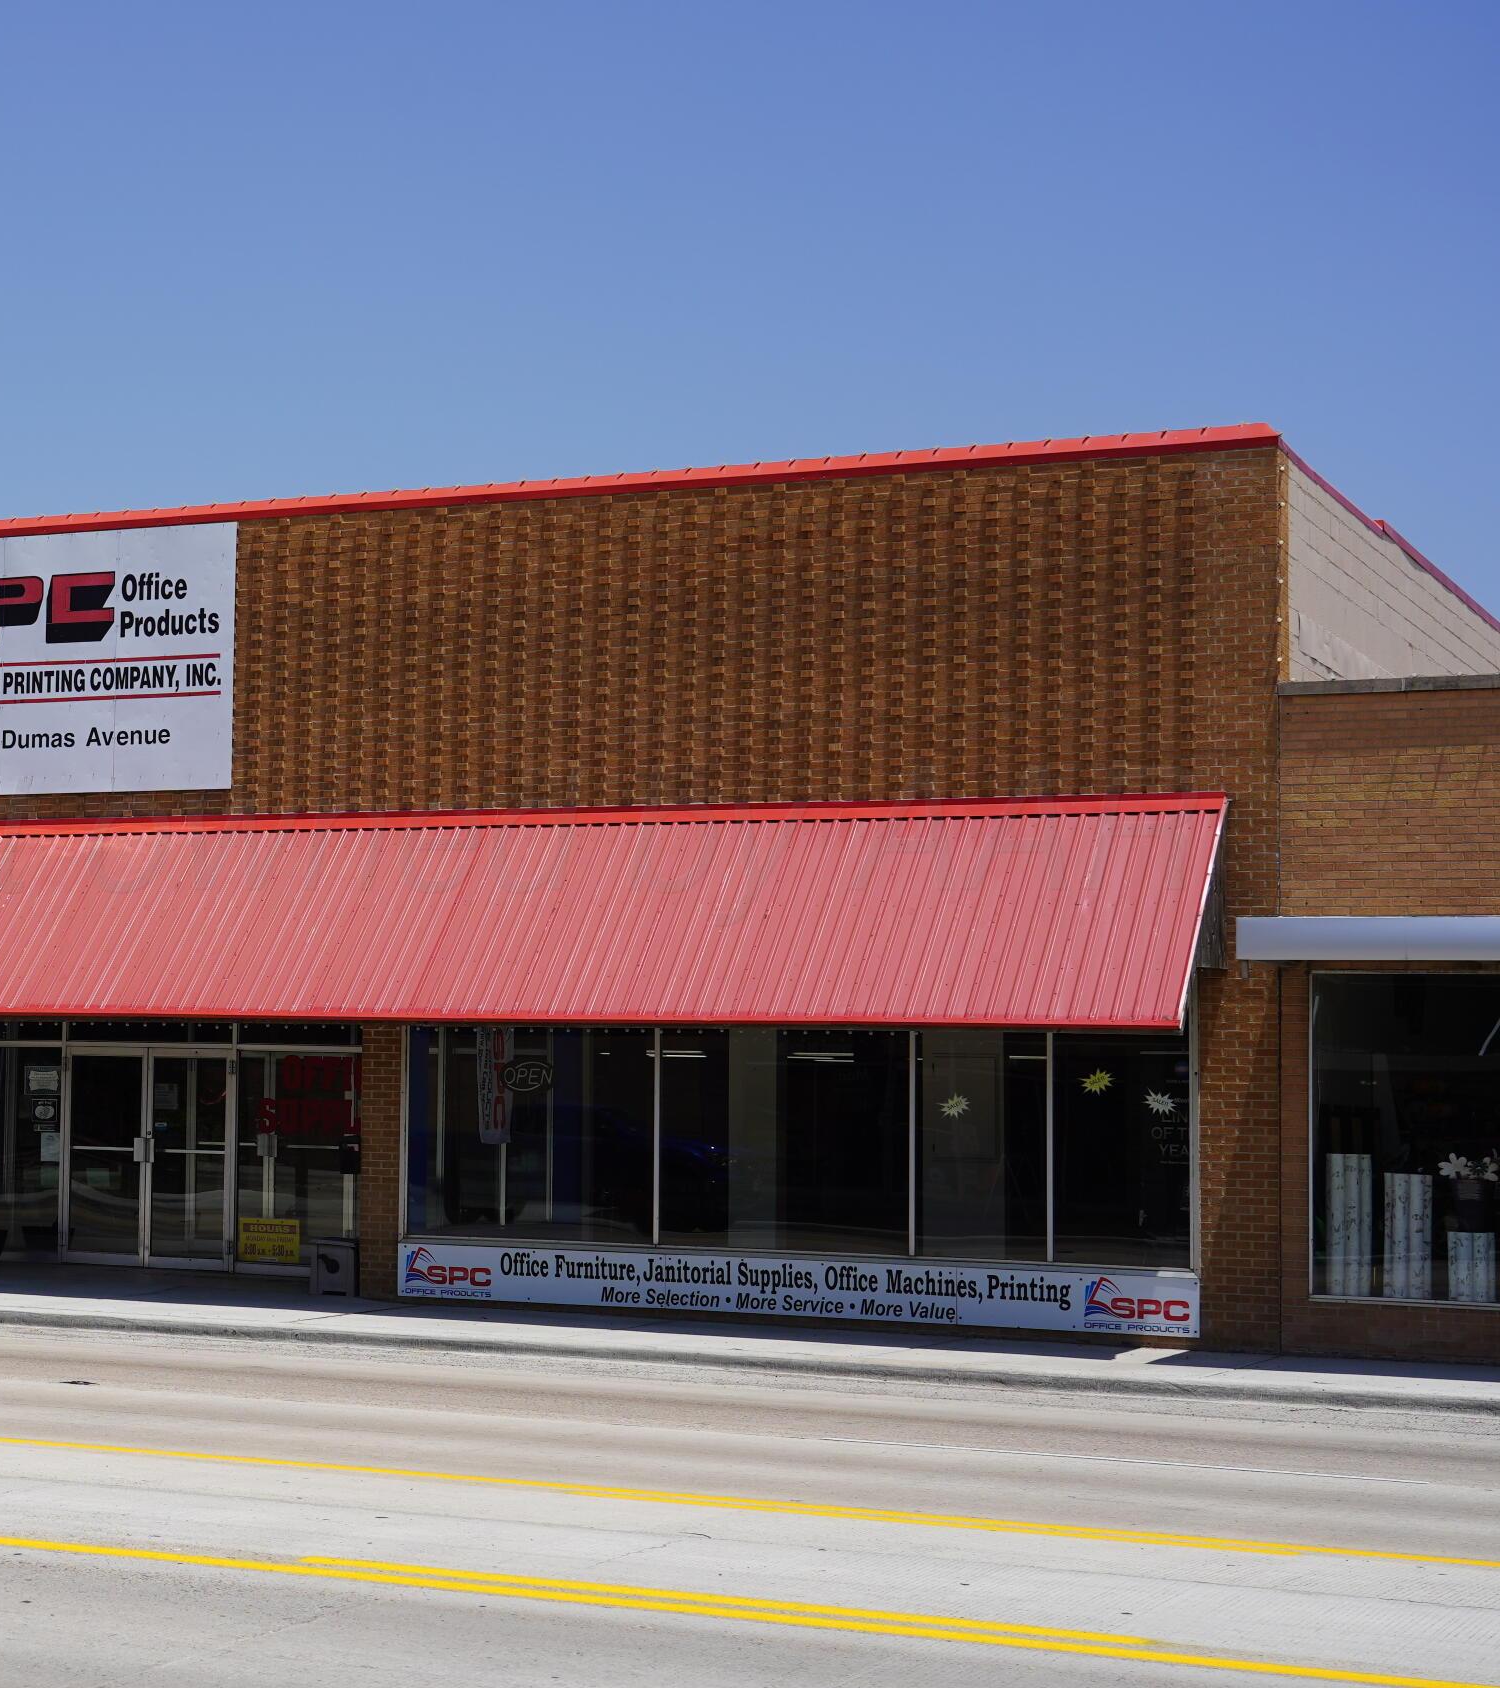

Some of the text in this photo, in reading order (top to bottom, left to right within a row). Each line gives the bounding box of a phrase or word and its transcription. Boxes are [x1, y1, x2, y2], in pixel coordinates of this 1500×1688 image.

[121, 572, 188, 602] Office
[120, 607, 220, 638] Products
[3, 668, 86, 695] PRINTING
[89, 664, 180, 692] COMPANY,
[185, 662, 222, 687] INC.
[1, 728, 76, 750] Dumas
[86, 725, 171, 747] Avenue
[504, 1066, 553, 1085] OPEN
[249, 1224, 290, 1233] HOURS
[426, 1265, 492, 1287] SPC
[500, 1253, 1071, 1311] Office Furniture, Janitorial Supplies, Office Machines, Printing
[404, 1286, 492, 1299] OFFICE PRODUCTS
[600, 1286, 643, 1305] More
[646, 1287, 721, 1308] Selection
[735, 1294, 778, 1312] More
[782, 1295, 843, 1315] Service
[860, 1298, 905, 1317] More
[1111, 1296, 1191, 1322] SPC
[1083, 1321, 1191, 1334] OFFICE PRODUCTS
